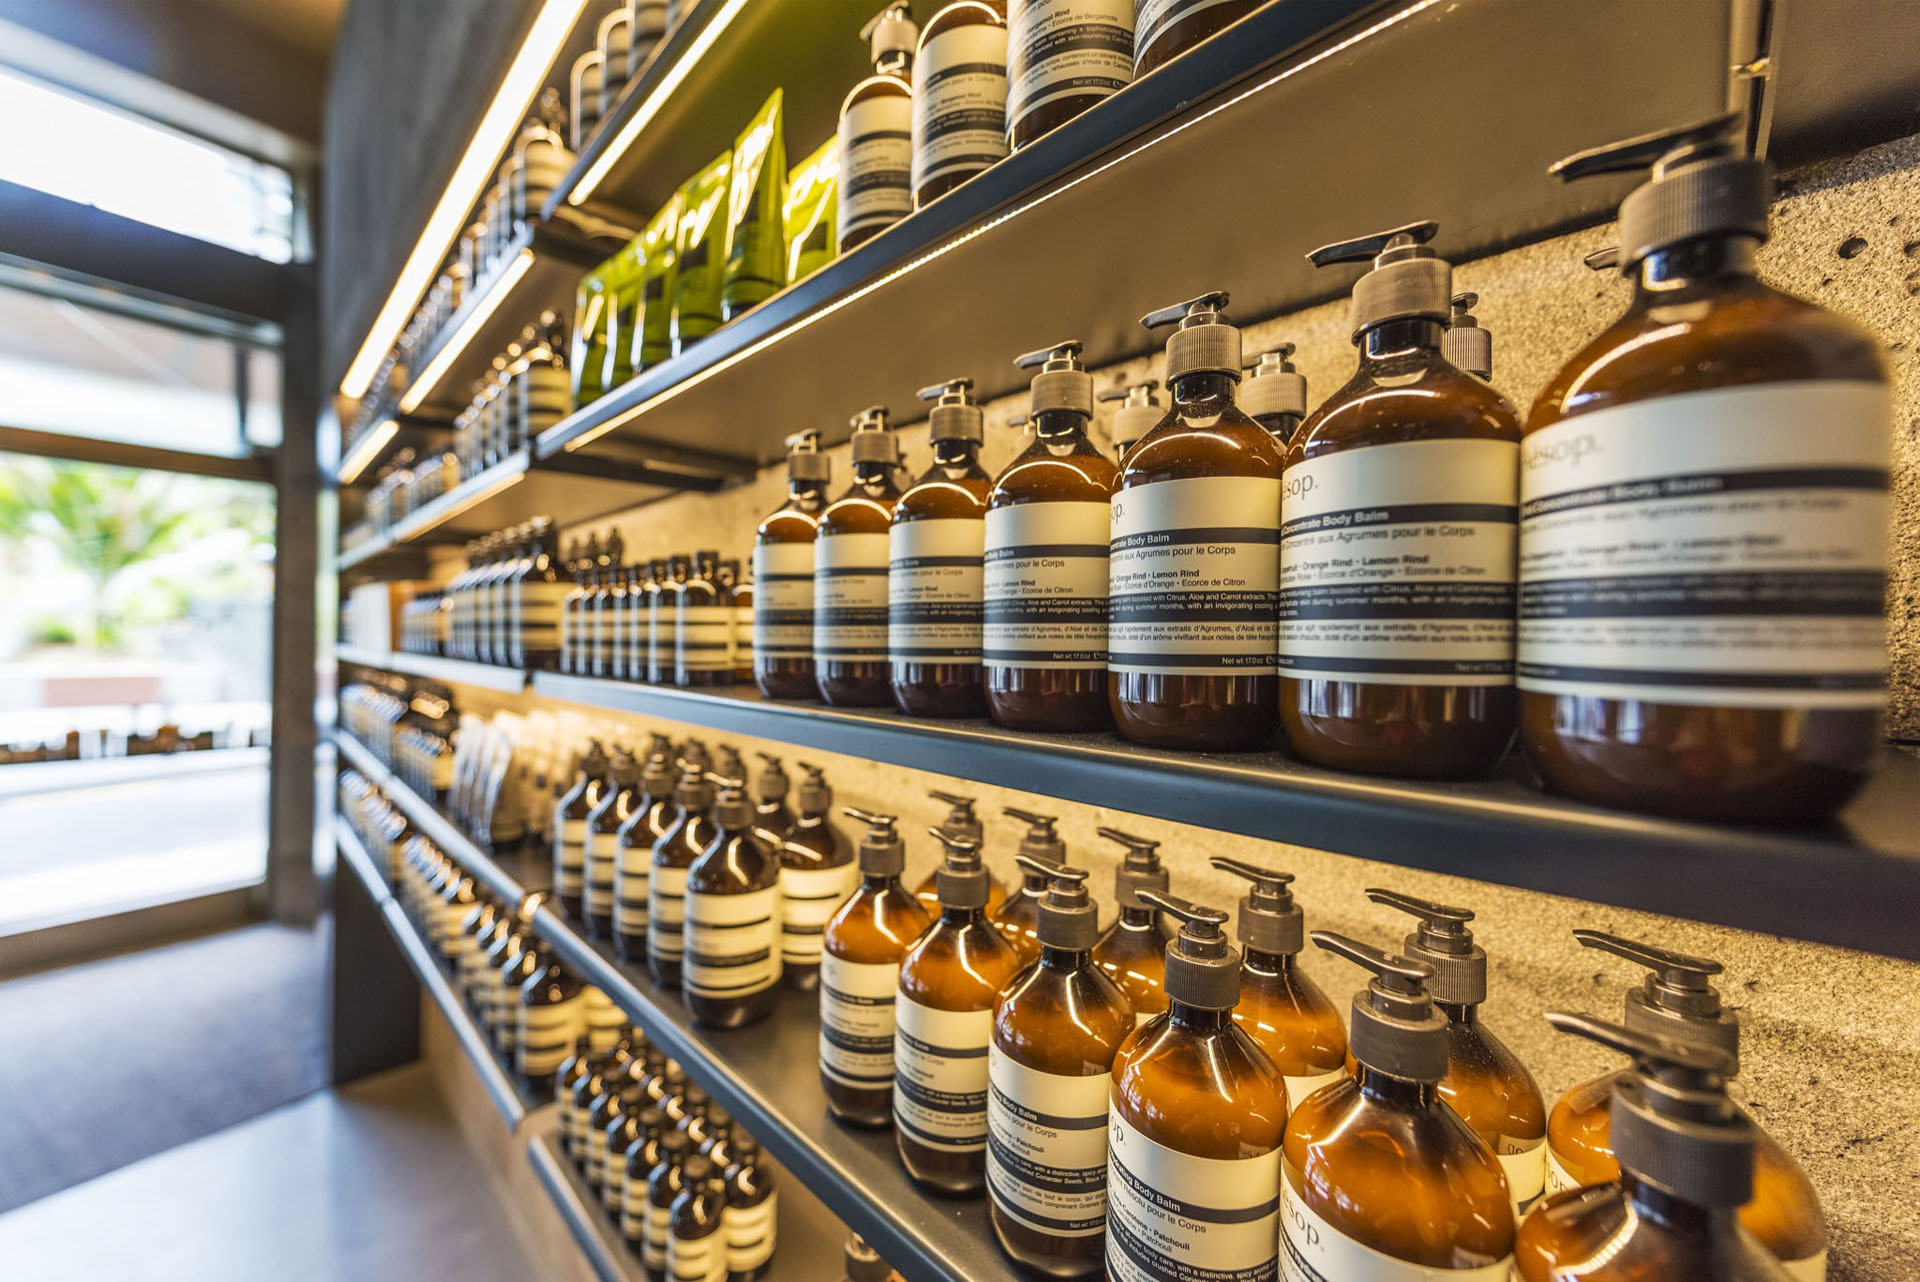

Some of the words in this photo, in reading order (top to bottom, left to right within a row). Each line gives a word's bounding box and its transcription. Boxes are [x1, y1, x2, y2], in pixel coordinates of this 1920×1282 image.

[1055, 8, 1070, 18] Rind
[1322, 515, 1352, 528] Body
[1355, 511, 1389, 523] Balm
[1128, 536, 1146, 548] Body
[1148, 534, 1170, 544] Balm
[1337, 528, 1389, 544] Agrumes
[1392, 527, 1422, 540] pour
[1424, 525, 1436, 537] le
[1439, 525, 1475, 538] Corps
[1136, 548, 1170, 560] Agrumes
[1172, 548, 1194, 558] pour
[1196, 546, 1205, 555] le
[1207, 546, 1236, 558] Corps
[1016, 561, 1031, 570] pour
[1042, 560, 1065, 568] Corps
[1331, 557, 1354, 568] Rind
[1362, 556, 1400, 566] Lemon
[1402, 554, 1430, 564] Rind
[1132, 571, 1146, 580] Rind
[1152, 570, 1178, 580] Lemon
[1180, 569, 1200, 578] Rind
[1143, 580, 1174, 590] d'Orange
[1222, 578, 1246, 586] Citron
[1153, 594, 1166, 602] with
[1166, 594, 1188, 602] Citrus,
[1220, 592, 1241, 600] Carrot
[1159, 603, 1184, 611] months,
[1187, 602, 1202, 610] with
[1216, 602, 1252, 611] invigorating
[1194, 624, 1232, 634] d'Agrumes,
[1152, 633, 1172, 641] arôme
[1174, 633, 1200, 641] vivifiant
[1018, 1108, 1038, 1122] Balm
[1034, 1126, 1058, 1139] Corps
[1134, 1180, 1155, 1200] Body
[1156, 1192, 1182, 1212] Balm
[1146, 1203, 1166, 1220] pour
[1167, 1214, 1176, 1225] le
[1178, 1218, 1208, 1234] Corps
[1142, 1230, 1173, 1254] Patchouli
[1153, 1228, 1190, 1251] Patchouli
[1144, 1246, 1159, 1261] body
[1160, 1256, 1176, 1270] care,
[1176, 1264, 1192, 1274] with
[1152, 1262, 1177, 1278] crushed
